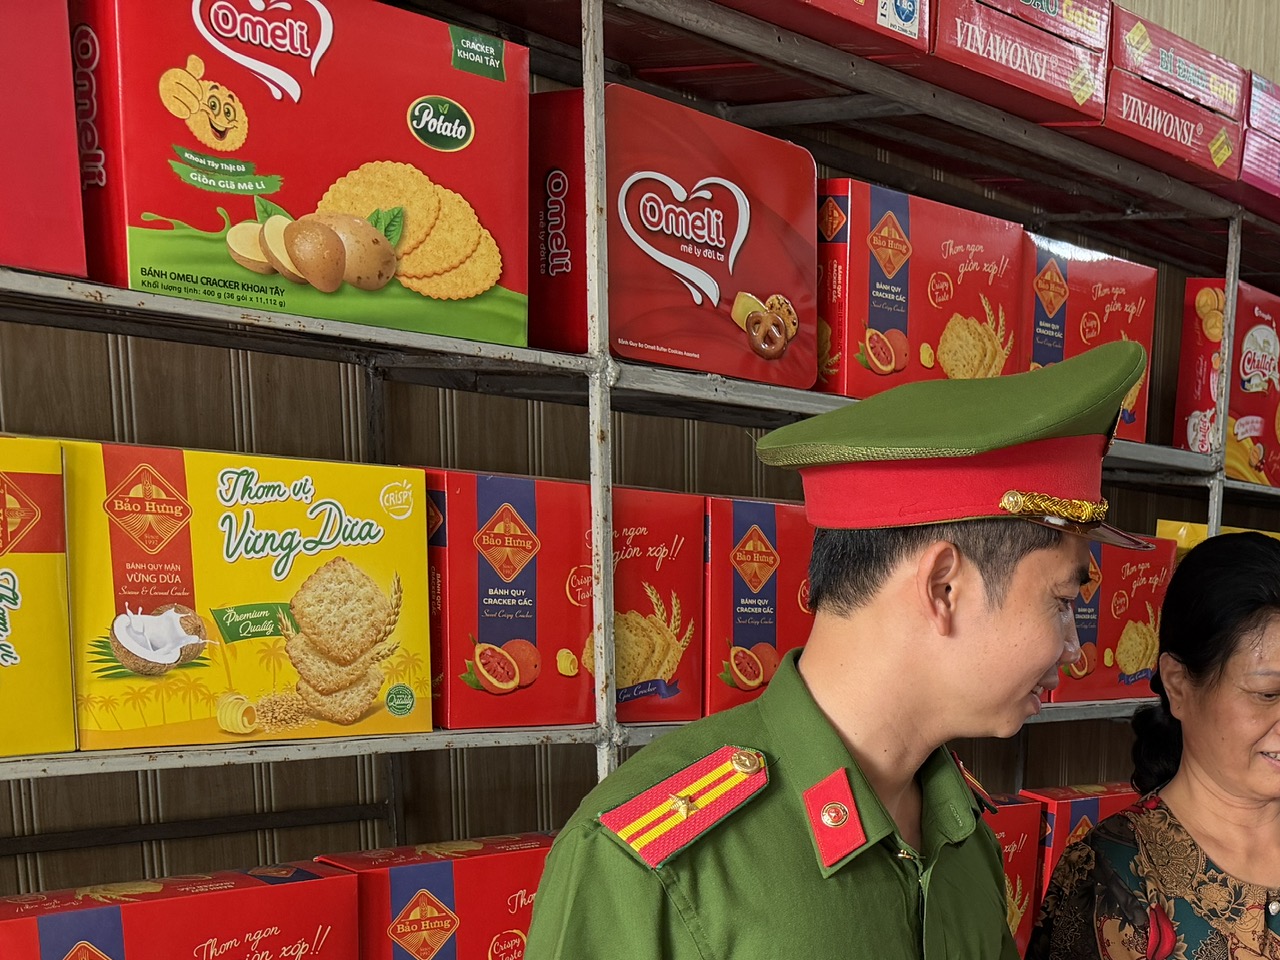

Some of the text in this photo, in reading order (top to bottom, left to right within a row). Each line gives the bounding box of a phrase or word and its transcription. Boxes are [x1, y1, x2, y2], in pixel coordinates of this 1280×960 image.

[211, 2, 311, 56] Omeli
[461, 39, 495, 56] CRACKER
[457, 49, 500, 69] KHOAI TÂY
[73, 25, 106, 186] Omeli
[413, 102, 466, 140] Potato
[190, 172, 216, 186] Giòn
[238, 181, 254, 191] Mê
[547, 169, 571, 276] Omeli
[640, 192, 725, 248] Omeli
[681, 244, 725, 262] mê ly đời ta
[872, 236, 907, 253] Bảo Hưng
[141, 267, 285, 296] BÁNH OMELI CRACKER KHOAI TÂY
[876, 281, 901, 292] BÁNH QUY
[141, 280, 159, 288] Khối
[279, 299, 285, 307] g)
[218, 467, 312, 504] Thơm vị
[384, 488, 413, 505] CRISPY
[114, 498, 183, 516] Bảo Hưng
[219, 500, 382, 580] Vừng Dừa
[482, 533, 532, 549] Bảo Hưng
[622, 525, 648, 543] ngon
[648, 534, 685, 571] xốp!!
[736, 551, 774, 565] Bảo Hưng
[126, 562, 180, 573] BÁNH QUY MẶN
[127, 573, 181, 584] VỪNG DỪA
[483, 597, 516, 605] CRACKER
[488, 587, 525, 597] BÁNH QUY
[223, 609, 270, 626] Premium
[239, 620, 274, 637] Quality
[396, 917, 451, 934] Bảo Hưng
[244, 922, 281, 955] ngon
[493, 937, 521, 954] Crispy
